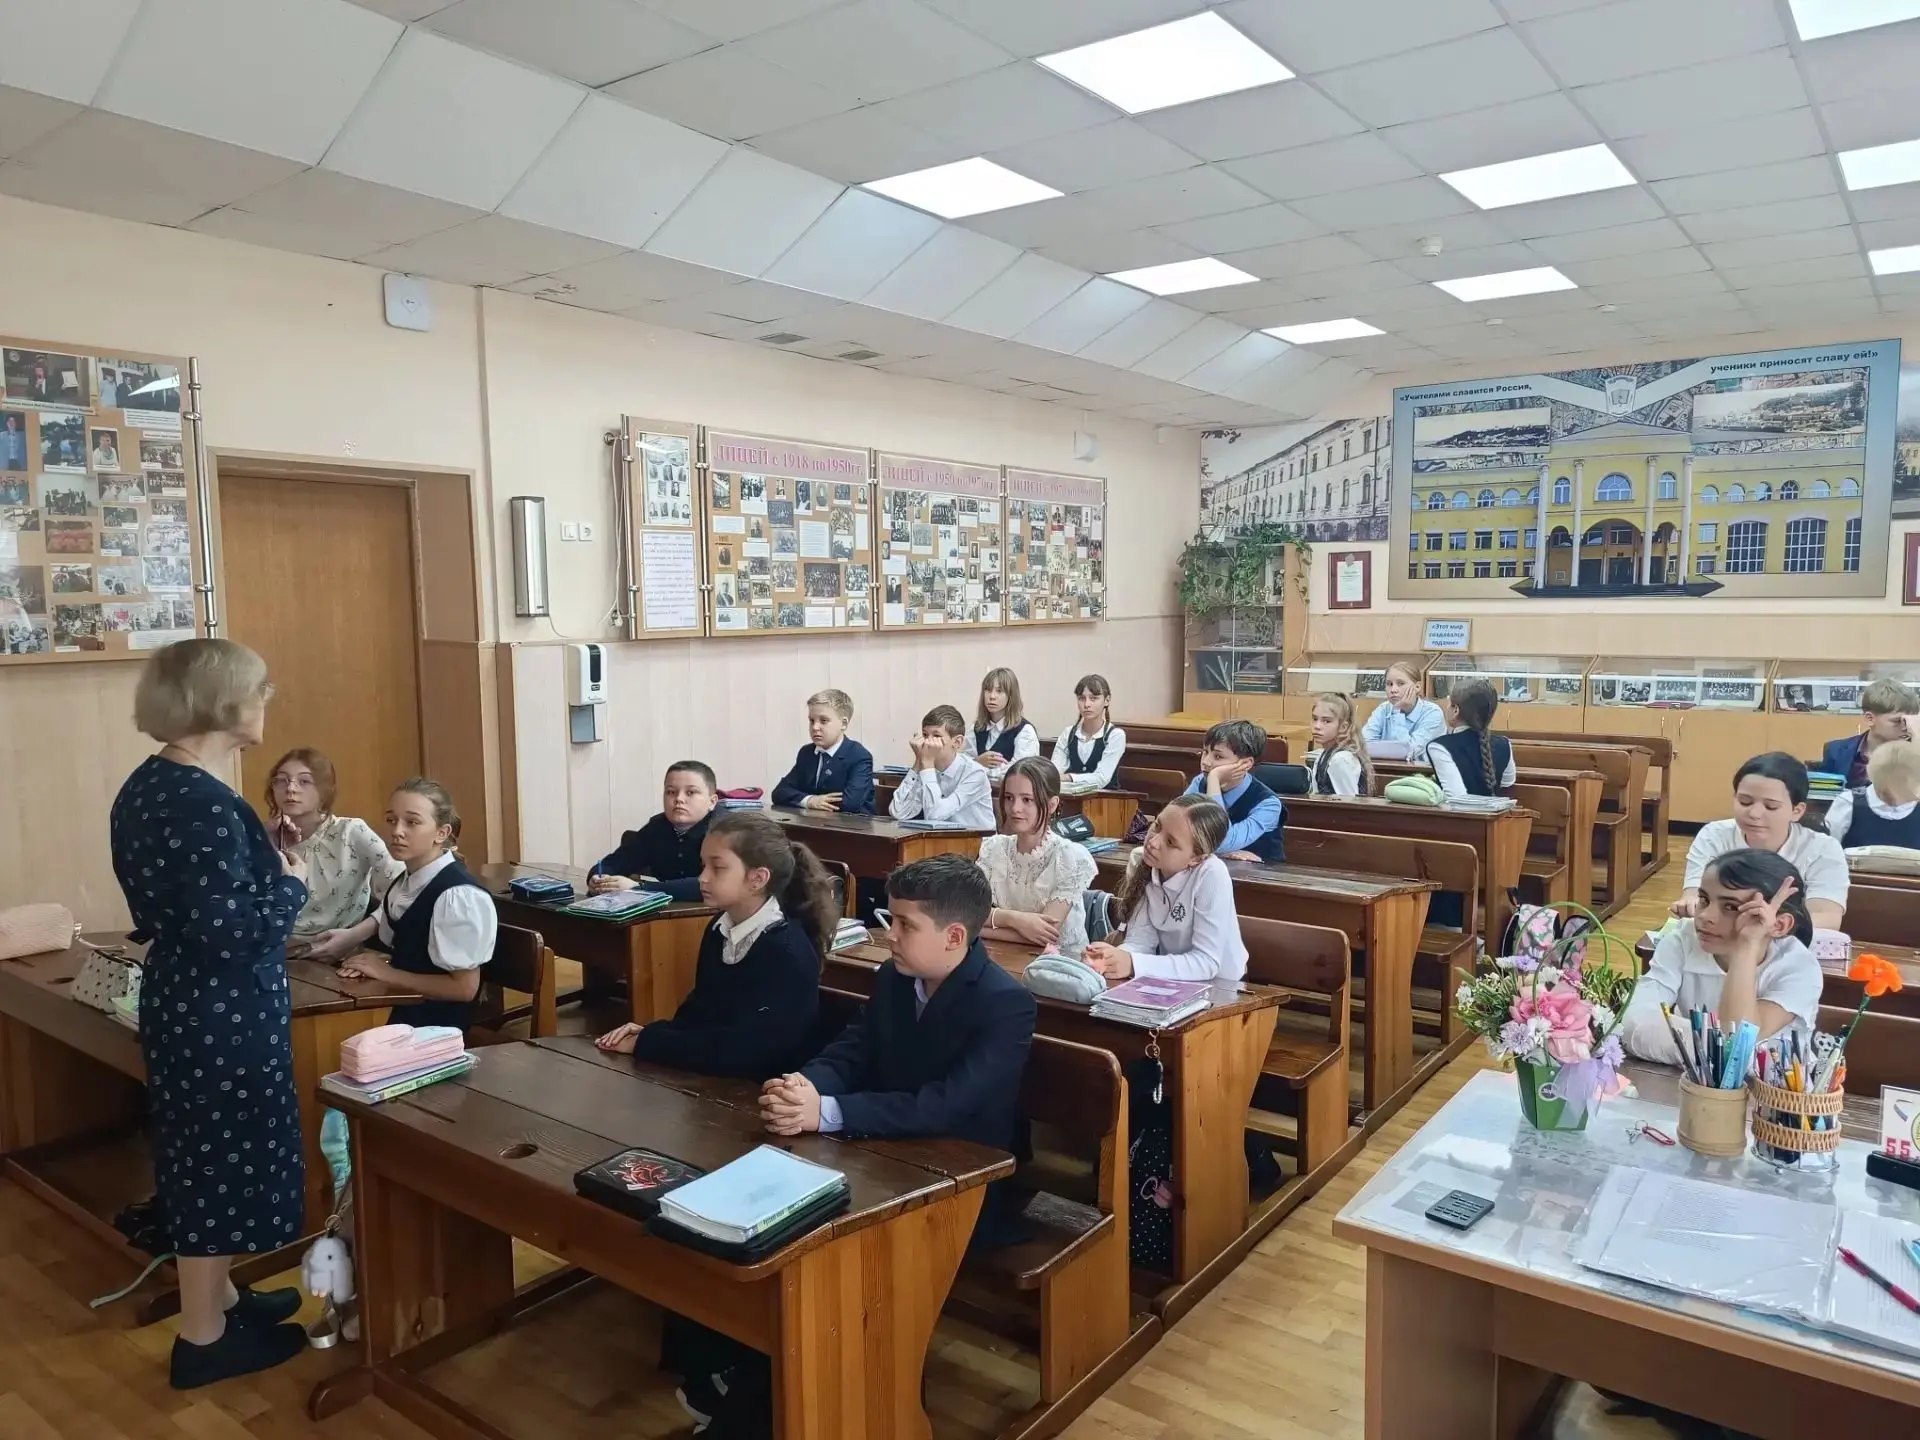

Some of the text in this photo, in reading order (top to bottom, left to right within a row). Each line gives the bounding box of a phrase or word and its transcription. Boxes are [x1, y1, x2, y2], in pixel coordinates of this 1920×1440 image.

[1711, 350, 1878, 374] ученики приносят славу ей!»
[1400, 384, 1532, 401] «Учителями славится Россия,
[714, 443, 769, 465] ЛИЦЕЙ
[772, 455, 778, 465] с
[784, 451, 809, 469] 1918
